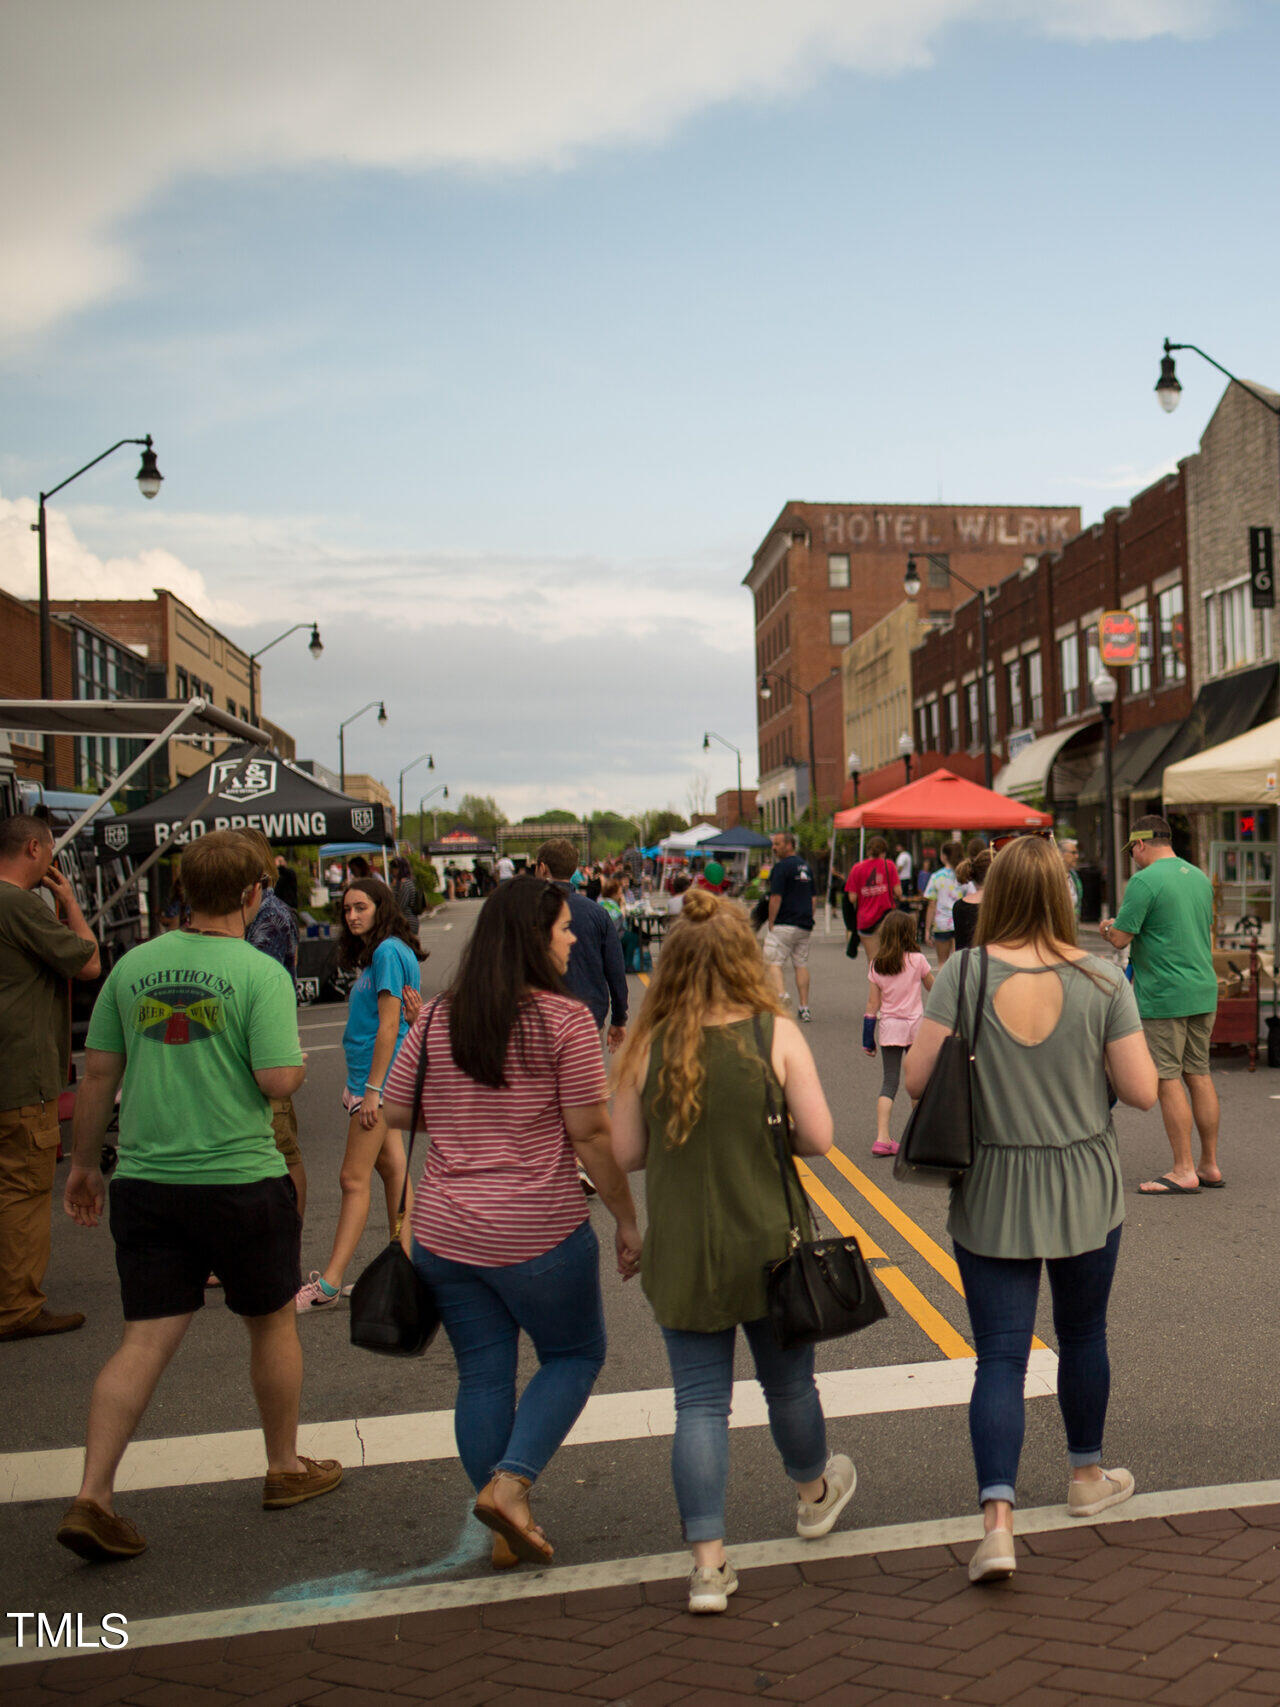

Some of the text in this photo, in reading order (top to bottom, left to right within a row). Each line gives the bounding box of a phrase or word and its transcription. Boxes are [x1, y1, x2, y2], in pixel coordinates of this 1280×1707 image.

[823, 513, 1071, 546] HOTEL WILRIK
[215, 811, 327, 838] BREWING
[131, 969, 235, 1000] LIGHTHOUSE
[139, 1006, 218, 1023] BEER WINE
